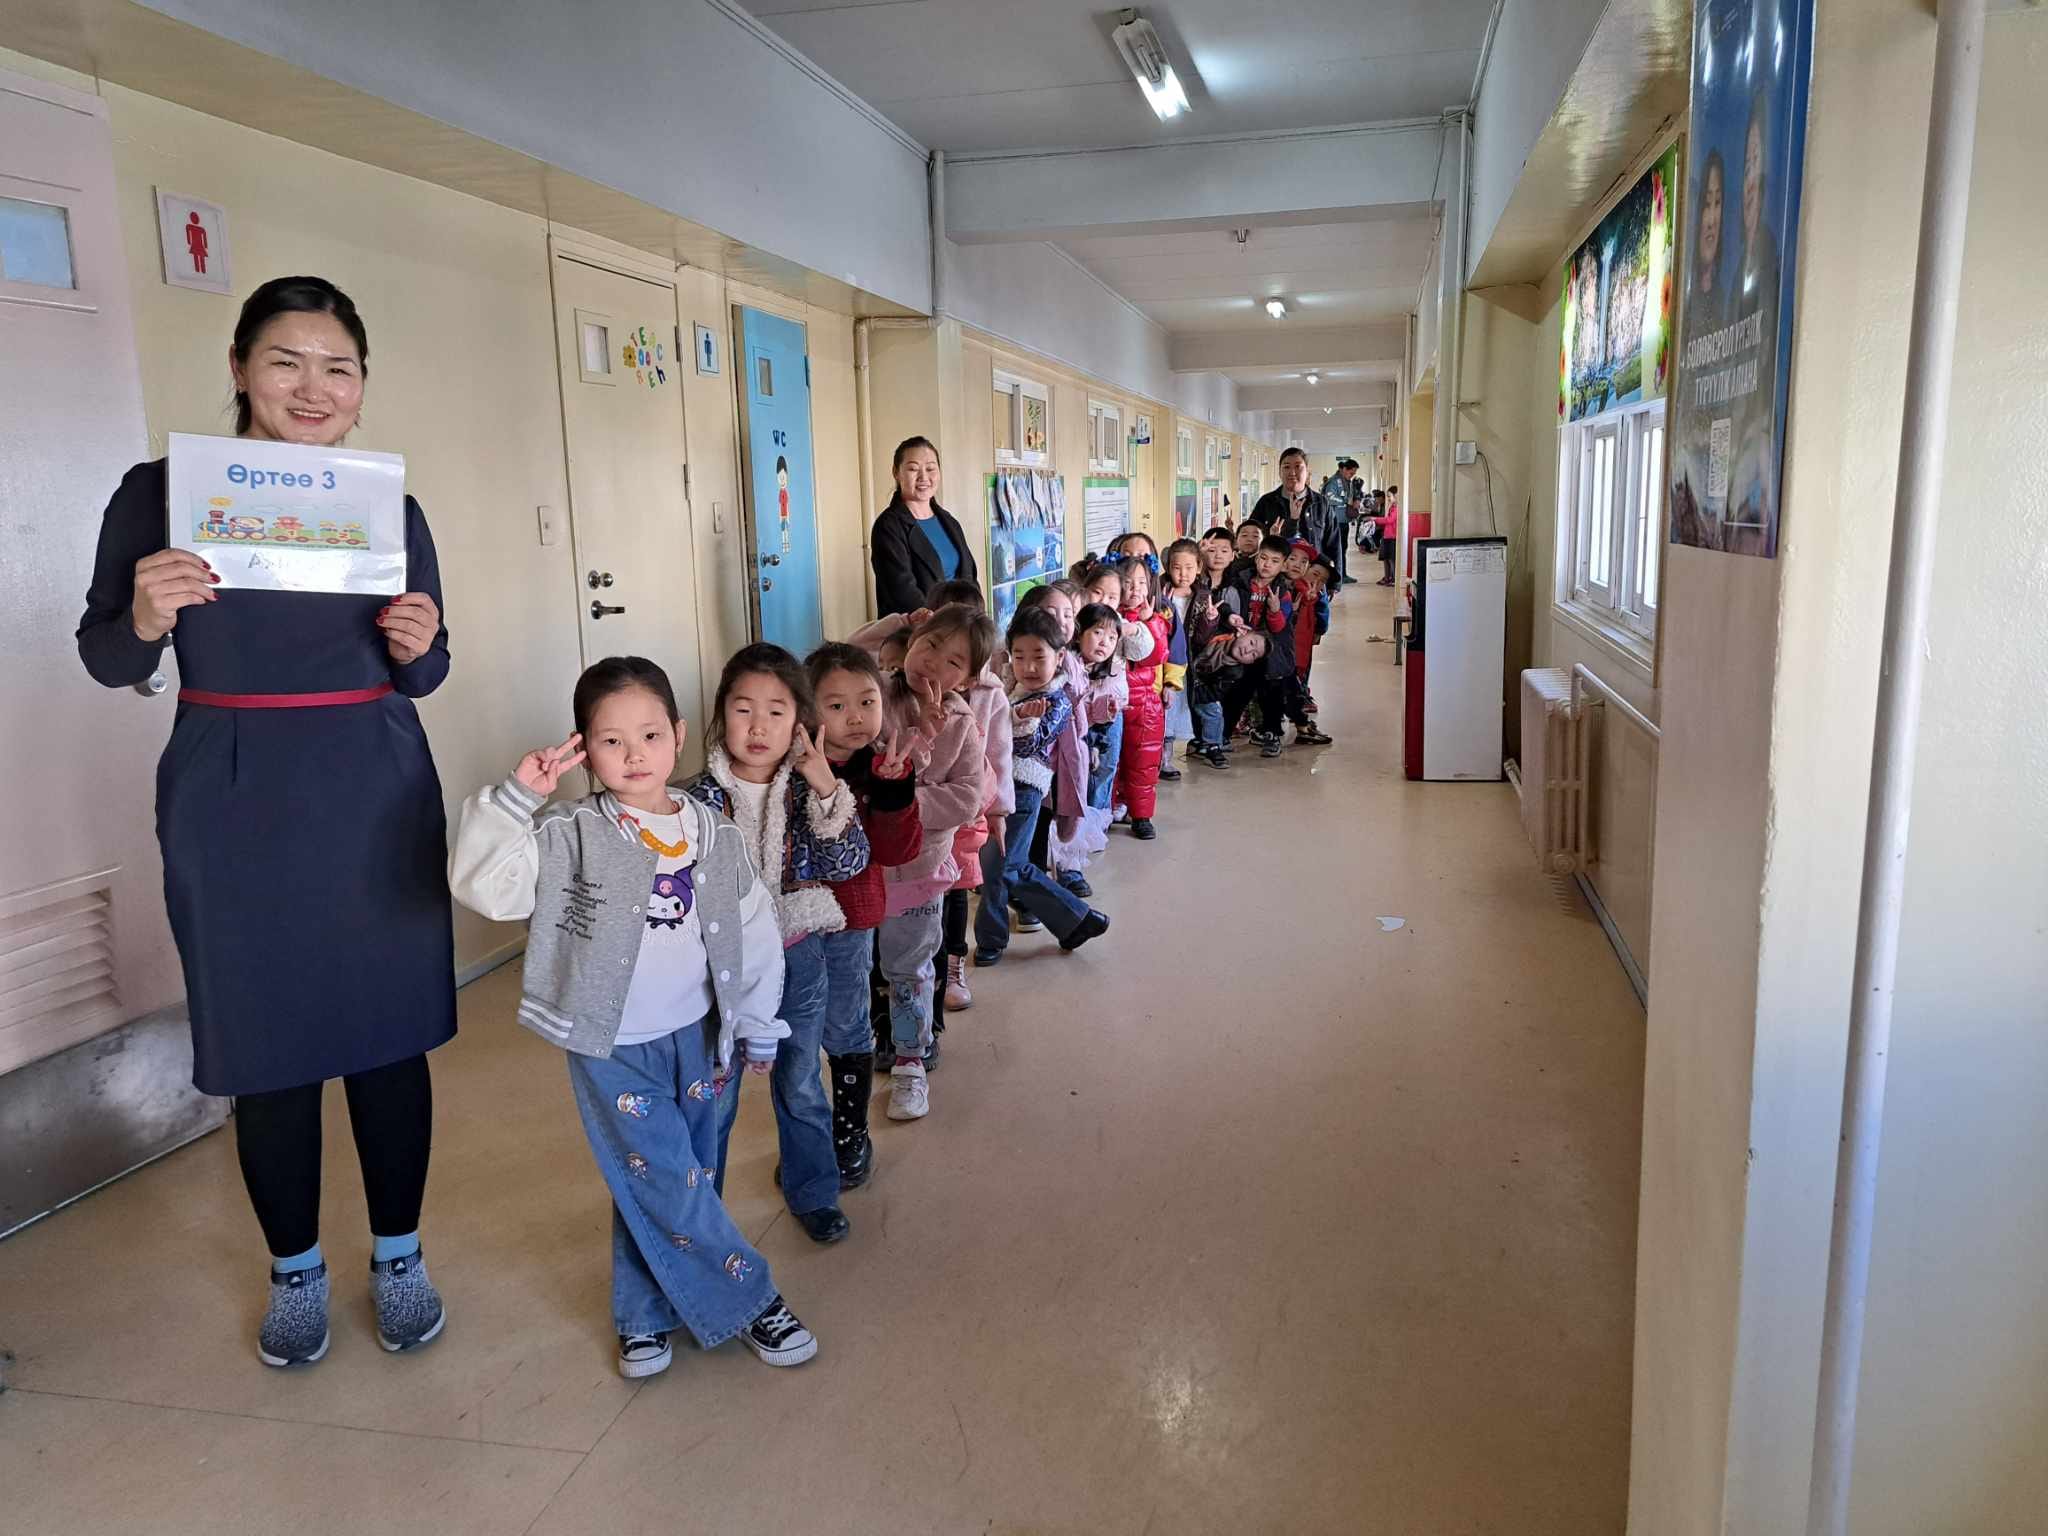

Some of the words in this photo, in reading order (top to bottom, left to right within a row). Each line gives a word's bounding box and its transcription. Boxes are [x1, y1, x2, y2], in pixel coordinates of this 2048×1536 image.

[772, 429, 786, 448] WC
[226, 463, 313, 489] Өртөө
[322, 470, 337, 489] 3
